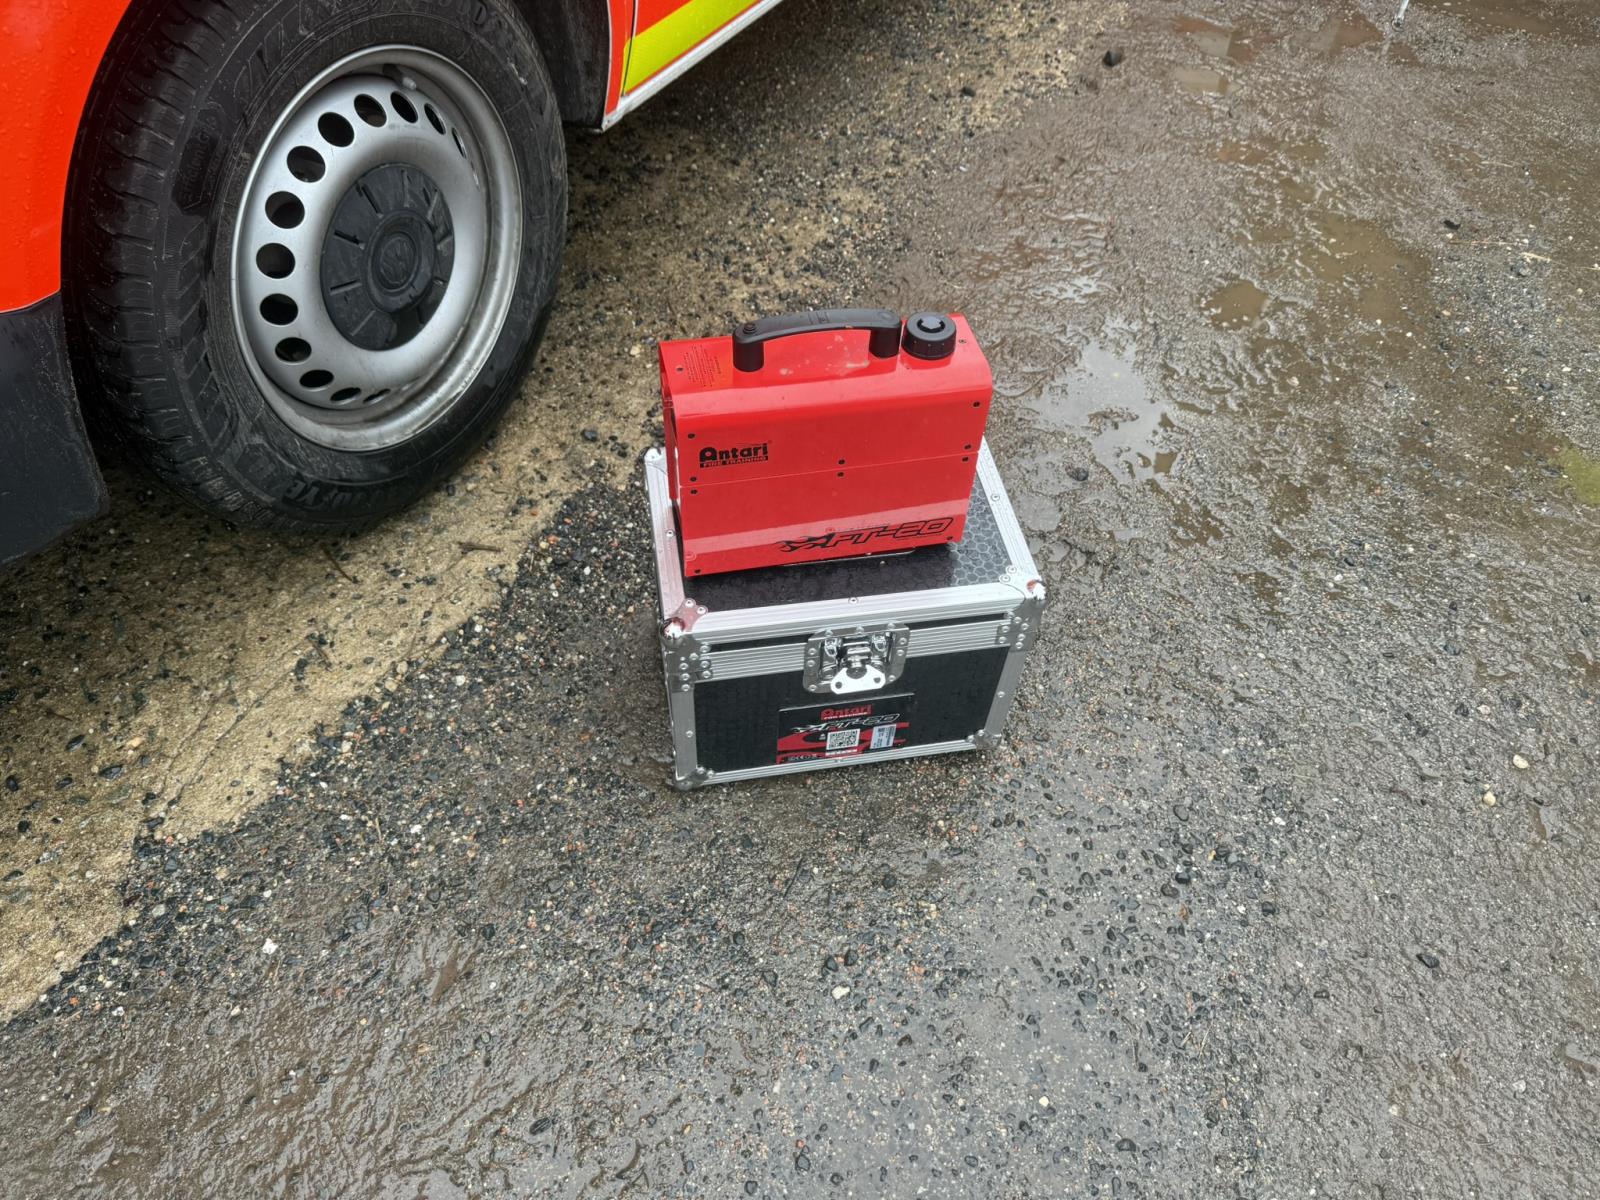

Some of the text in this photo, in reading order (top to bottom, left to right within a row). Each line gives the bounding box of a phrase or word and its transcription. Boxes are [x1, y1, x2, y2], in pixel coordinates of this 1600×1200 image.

[699, 443, 768, 462] Antari
[820, 517, 953, 548] FT-20
[821, 704, 873, 719] Antari
